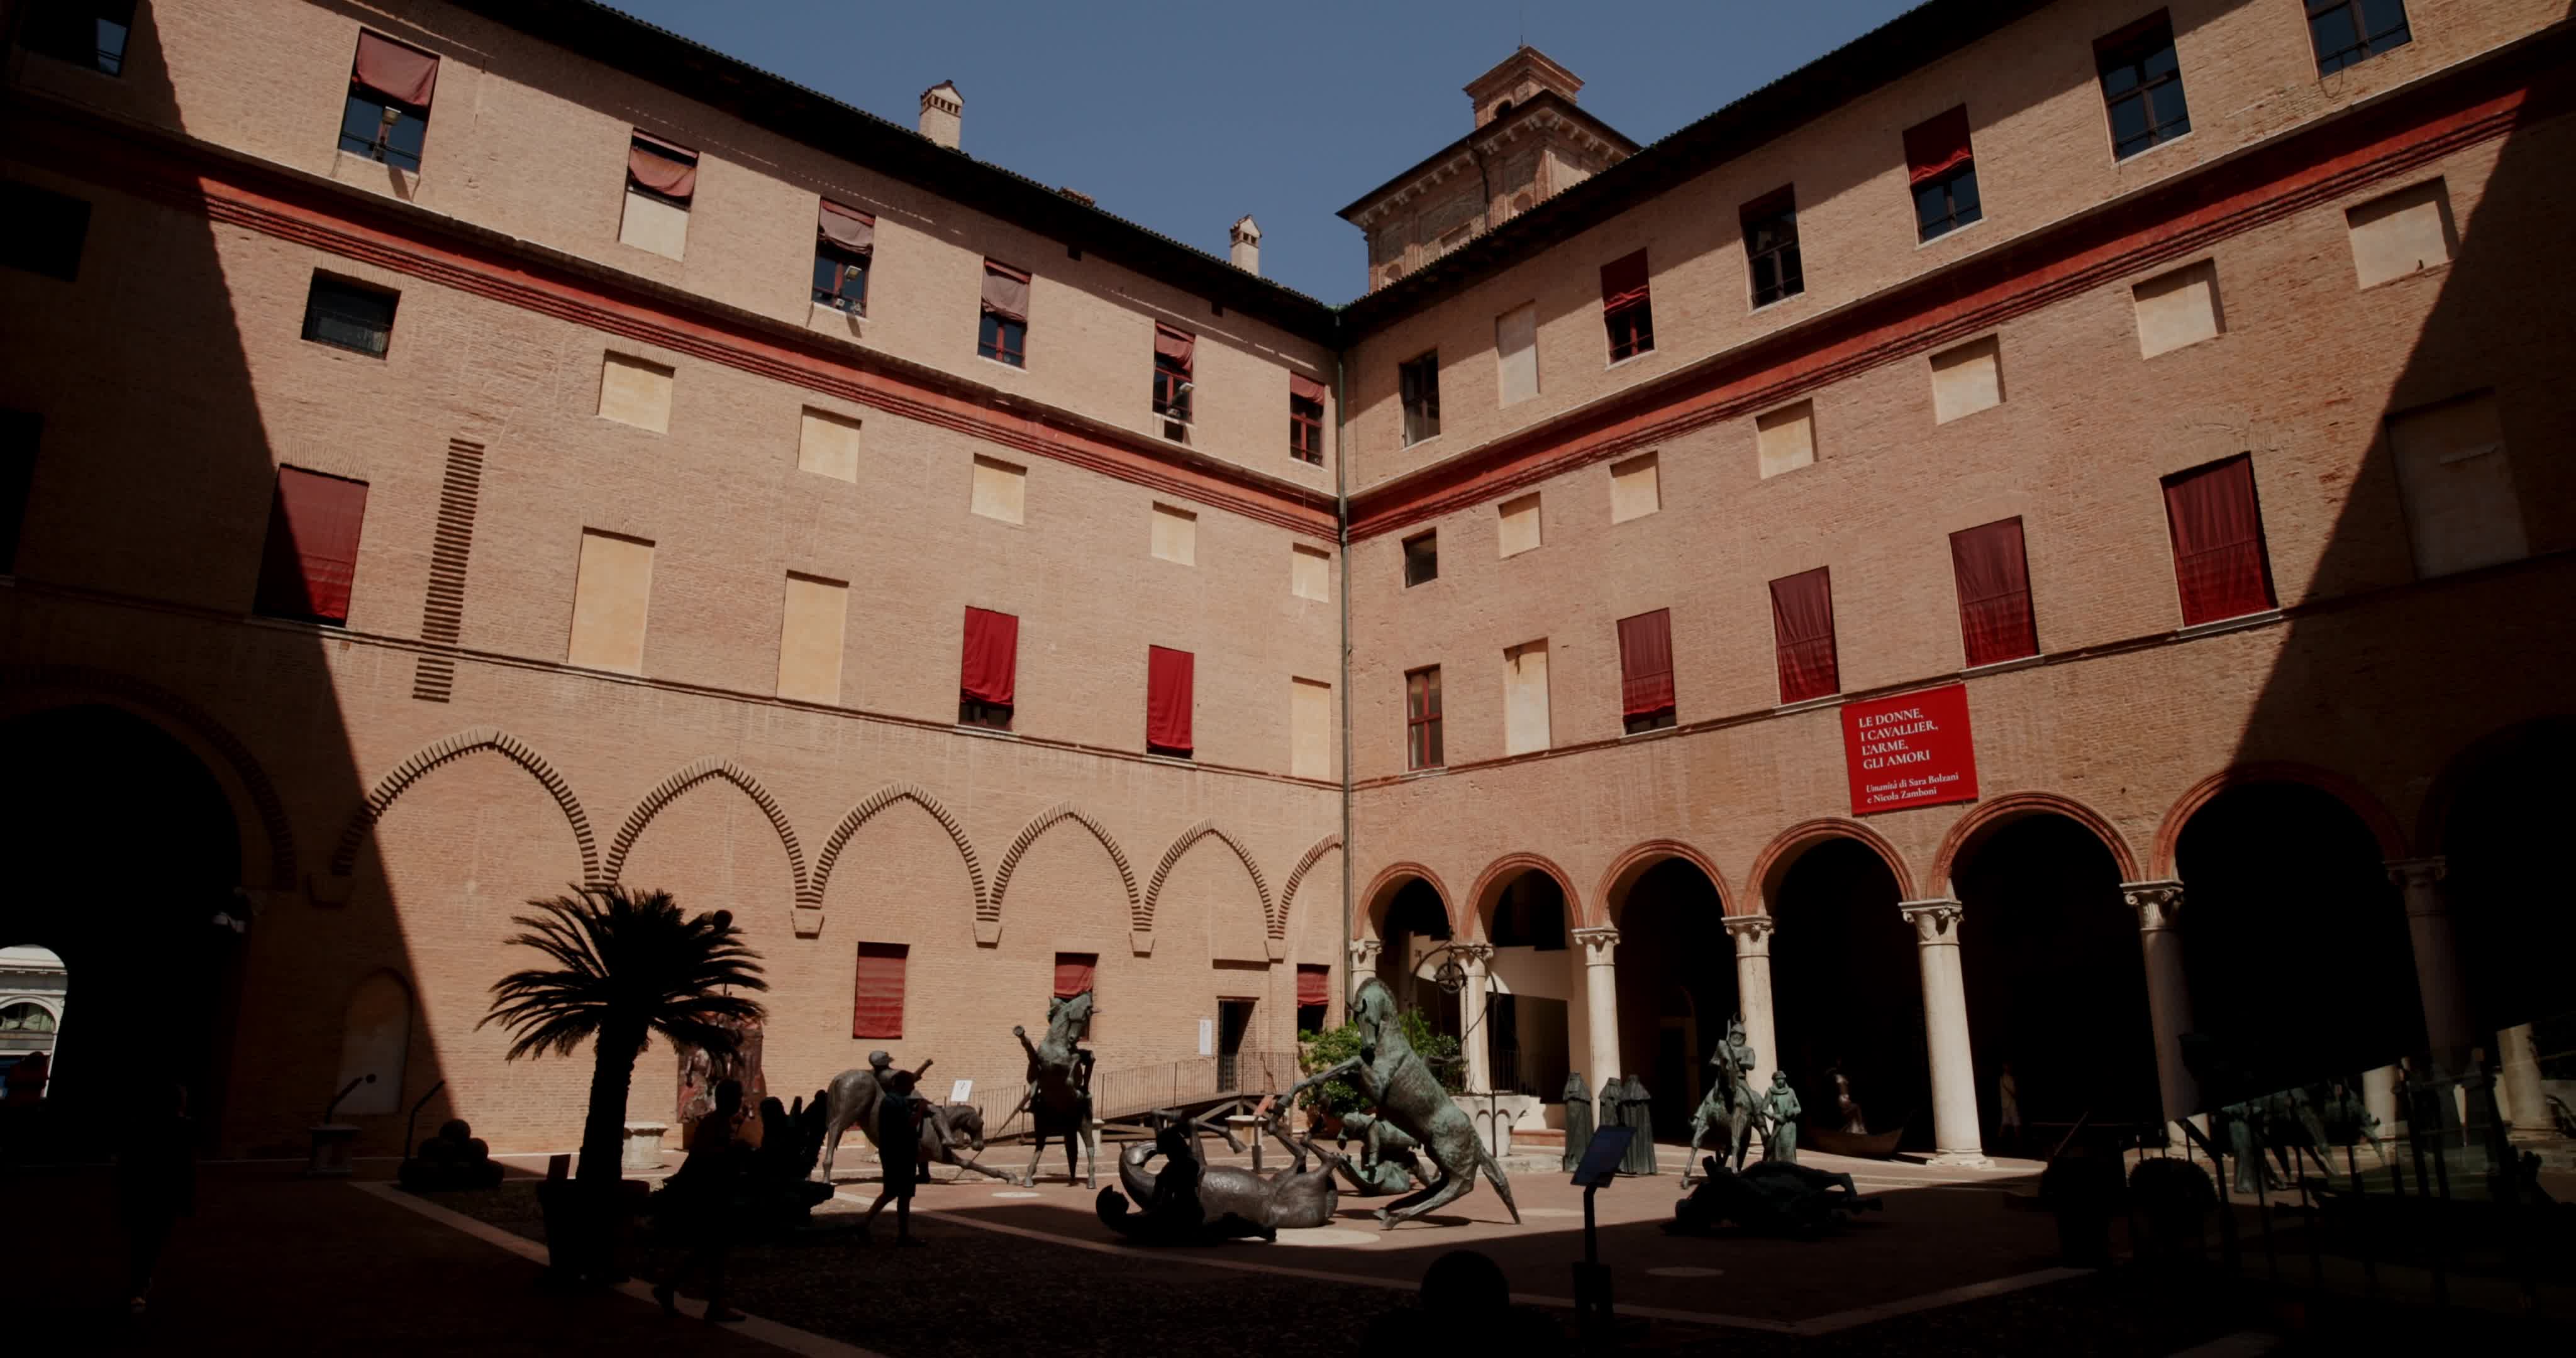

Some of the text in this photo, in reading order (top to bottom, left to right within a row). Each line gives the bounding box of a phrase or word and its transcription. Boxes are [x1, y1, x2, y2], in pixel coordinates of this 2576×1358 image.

[1858, 708, 1923, 728] LE DONNE,
[1861, 731, 1865, 742] I
[1863, 749, 1930, 770] GLI AMORI
[1899, 779, 1907, 788] di
[1909, 778, 1926, 787] Sara
[1928, 772, 1959, 784] Bolzani
[1874, 792, 1899, 802] Nicola
[1901, 787, 1937, 799] Zamboni
